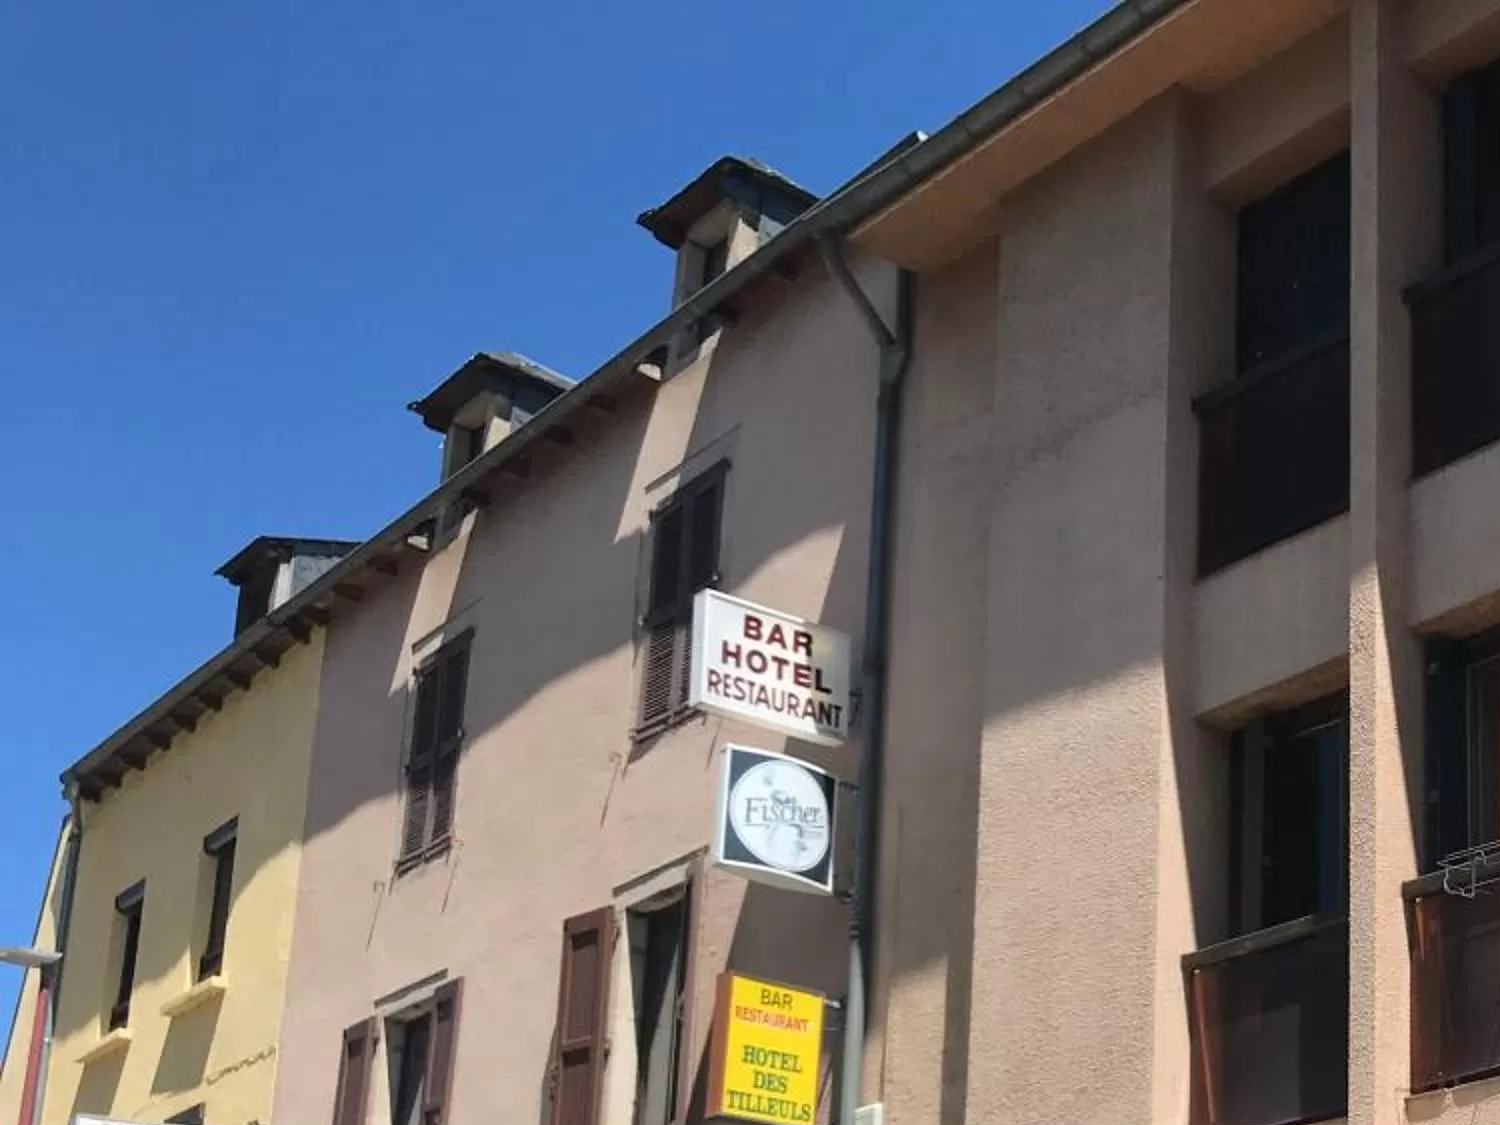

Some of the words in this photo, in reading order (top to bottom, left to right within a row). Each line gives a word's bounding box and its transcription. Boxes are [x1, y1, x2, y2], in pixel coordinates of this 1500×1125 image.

[743, 613, 813, 656] BAR
[721, 640, 833, 694] HOTEL
[707, 669, 843, 729] RESTAURANT
[760, 988, 794, 1010] BAR
[735, 1005, 810, 1032] RESTAURANT
[742, 1045, 803, 1074] HOTEL
[753, 1071, 788, 1093] DES
[727, 1091, 812, 1123] TILLEULS
